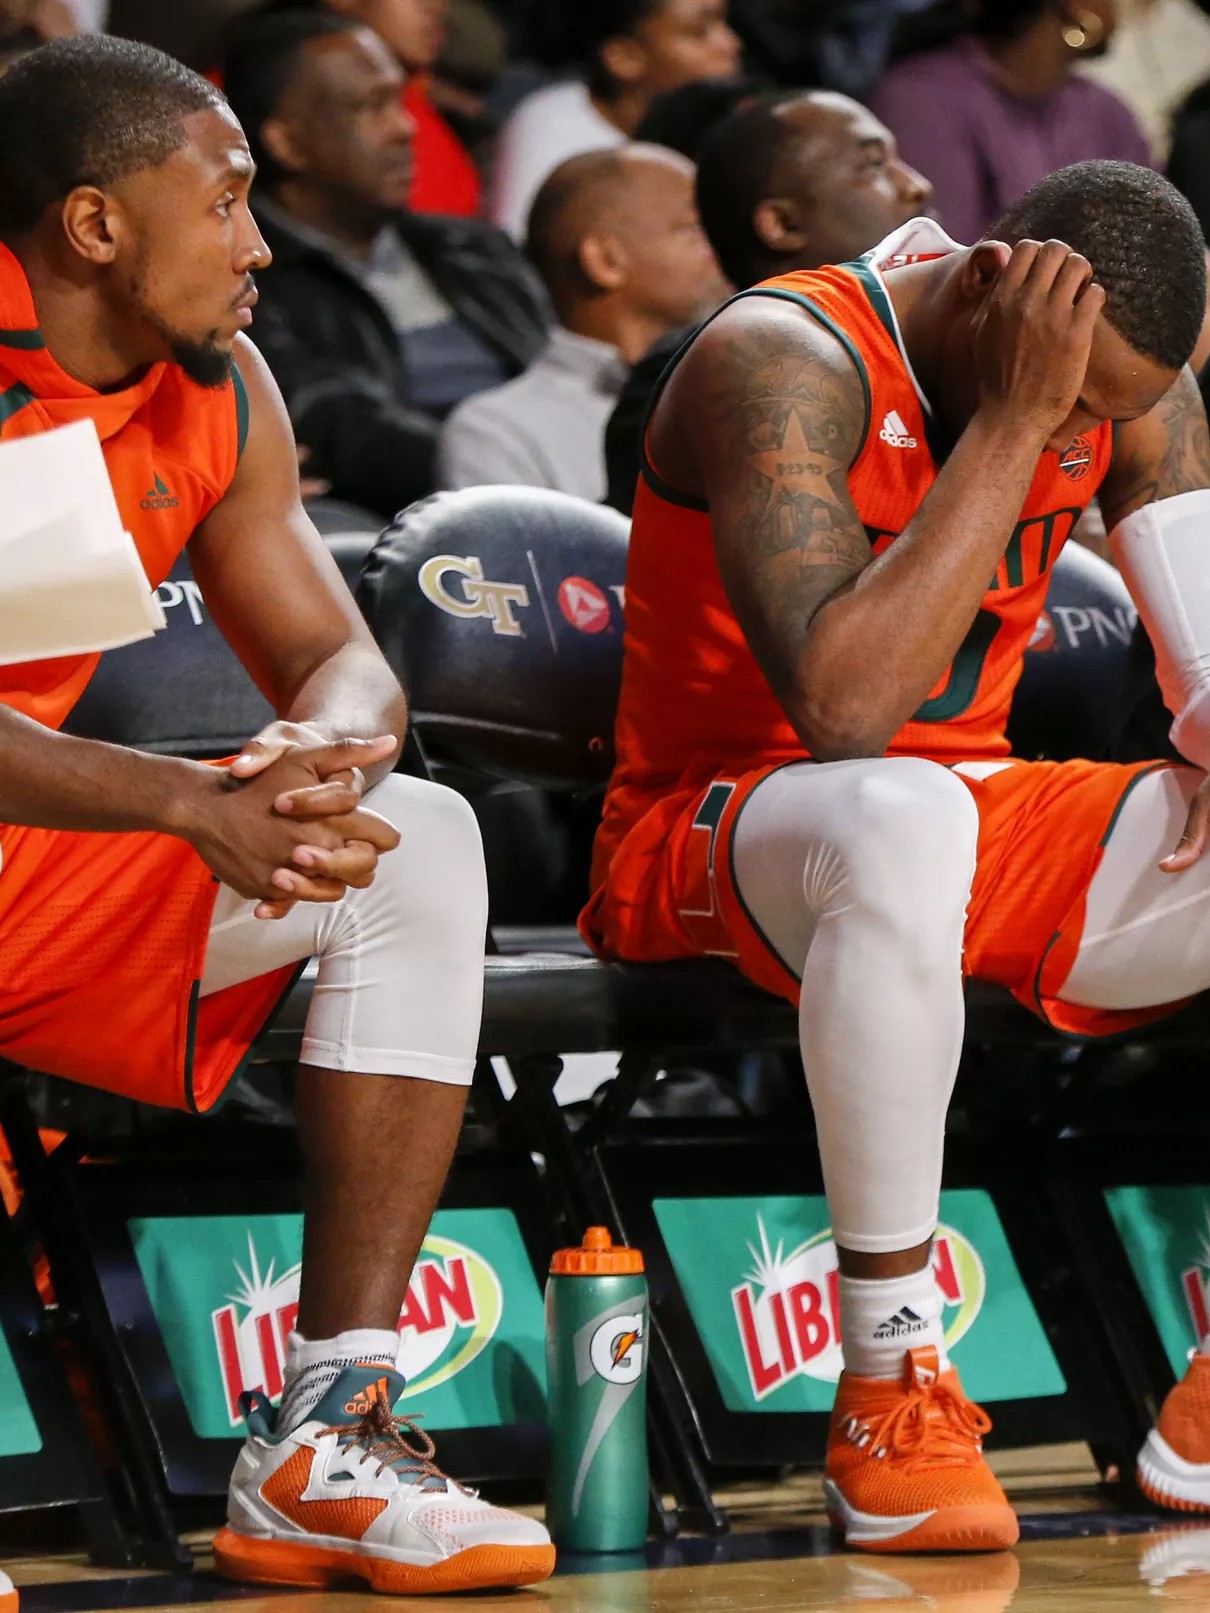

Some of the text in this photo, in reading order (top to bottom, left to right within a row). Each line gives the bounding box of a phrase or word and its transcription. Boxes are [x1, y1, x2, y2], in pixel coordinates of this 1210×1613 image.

[1052, 606, 1138, 648] PN
[213, 1257, 478, 1424] LIAN
[734, 1237, 963, 1396] LIBN
[873, 1319, 929, 1339] adidas
